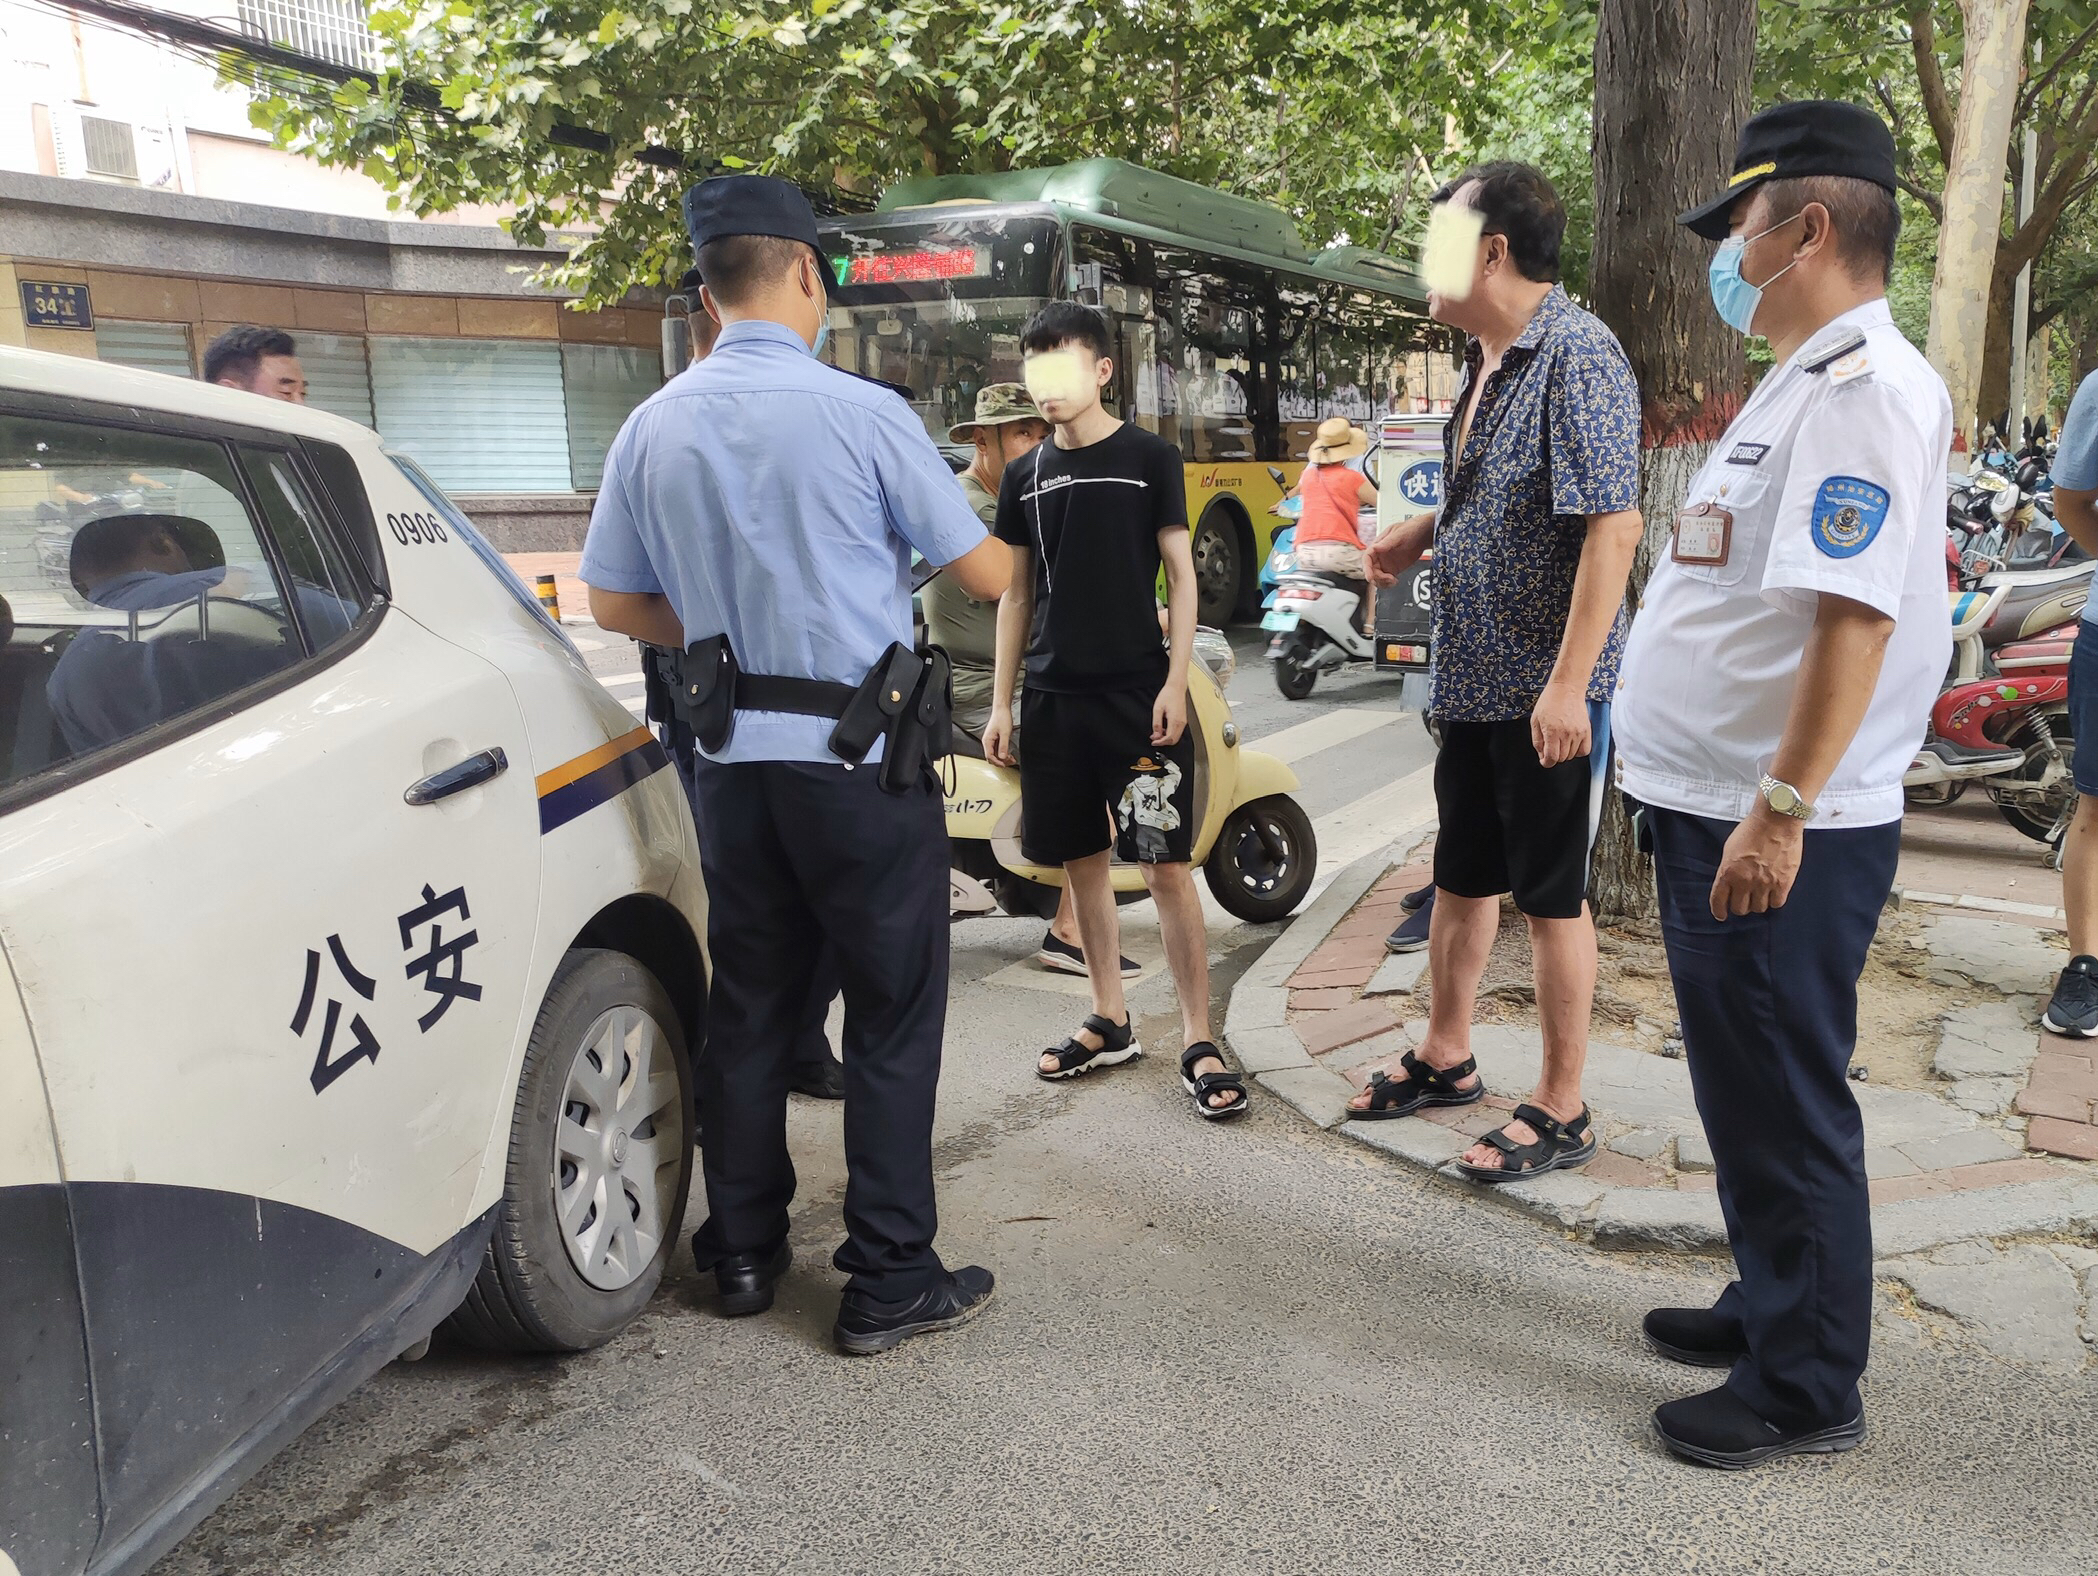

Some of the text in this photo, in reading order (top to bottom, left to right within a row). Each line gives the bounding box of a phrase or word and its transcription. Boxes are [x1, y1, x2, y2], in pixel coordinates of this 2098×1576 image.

[1048, 475, 1072, 487] inches
[387, 512, 448, 546] 0906
[1420, 580, 1431, 601] S
[290, 882, 483, 1097] 公安
